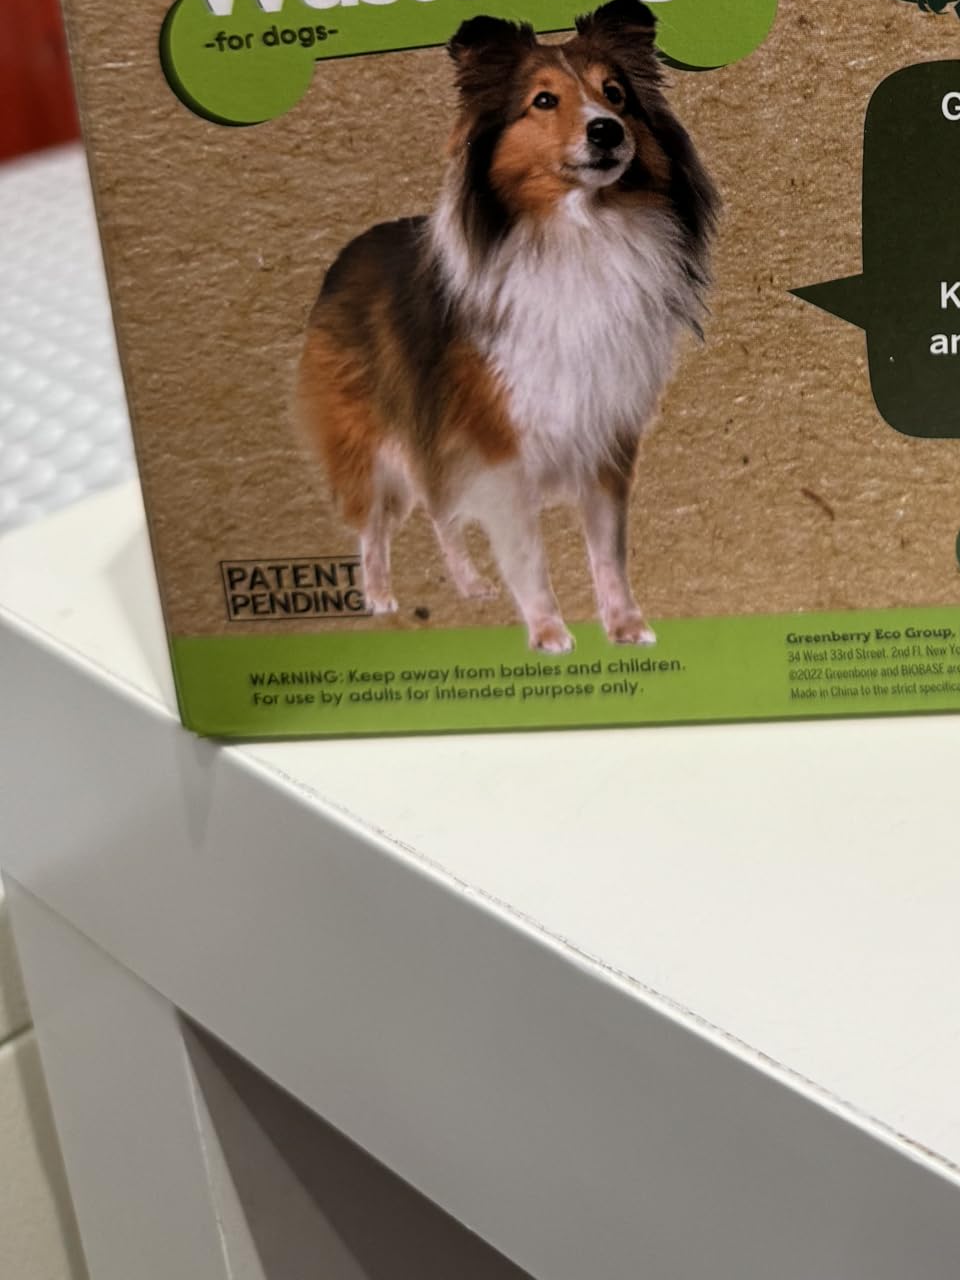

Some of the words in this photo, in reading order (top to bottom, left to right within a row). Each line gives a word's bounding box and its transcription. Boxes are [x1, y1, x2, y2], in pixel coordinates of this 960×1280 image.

[227, 562, 361, 591] PATENT
[231, 589, 366, 616] PENDING
[787, 630, 871, 644] Greenberry
[875, 629, 900, 640] Eco
[905, 627, 955, 640] Group,
[788, 651, 800, 663] 34
[804, 650, 827, 662] West
[831, 649, 854, 661] 33rd
[891, 647, 910, 658] 2nd
[926, 645, 946, 657] New
[250, 670, 345, 687] WARNING:
[348, 668, 396, 685] Keep
[400, 668, 450, 682] away
[454, 665, 495, 679] from
[501, 662, 562, 677] babies
[567, 660, 601, 675] and
[607, 658, 686, 674] children.
[825, 667, 878, 680] Greenbone
[880, 666, 899, 677] and
[901, 663, 944, 676] BIOBASE
[253, 692, 279, 705] For
[285, 693, 315, 704] use
[321, 691, 343, 706] by
[350, 688, 402, 703] adults
[407, 686, 429, 701] for
[436, 685, 516, 700] intended
[522, 682, 595, 699] purpose
[601, 679, 644, 699] only.
[791, 688, 817, 699] Made
[820, 687, 828, 697] in
[831, 685, 859, 697] China
[861, 685, 871, 696] to
[874, 684, 889, 695] the
[891, 683, 917, 695] strict
